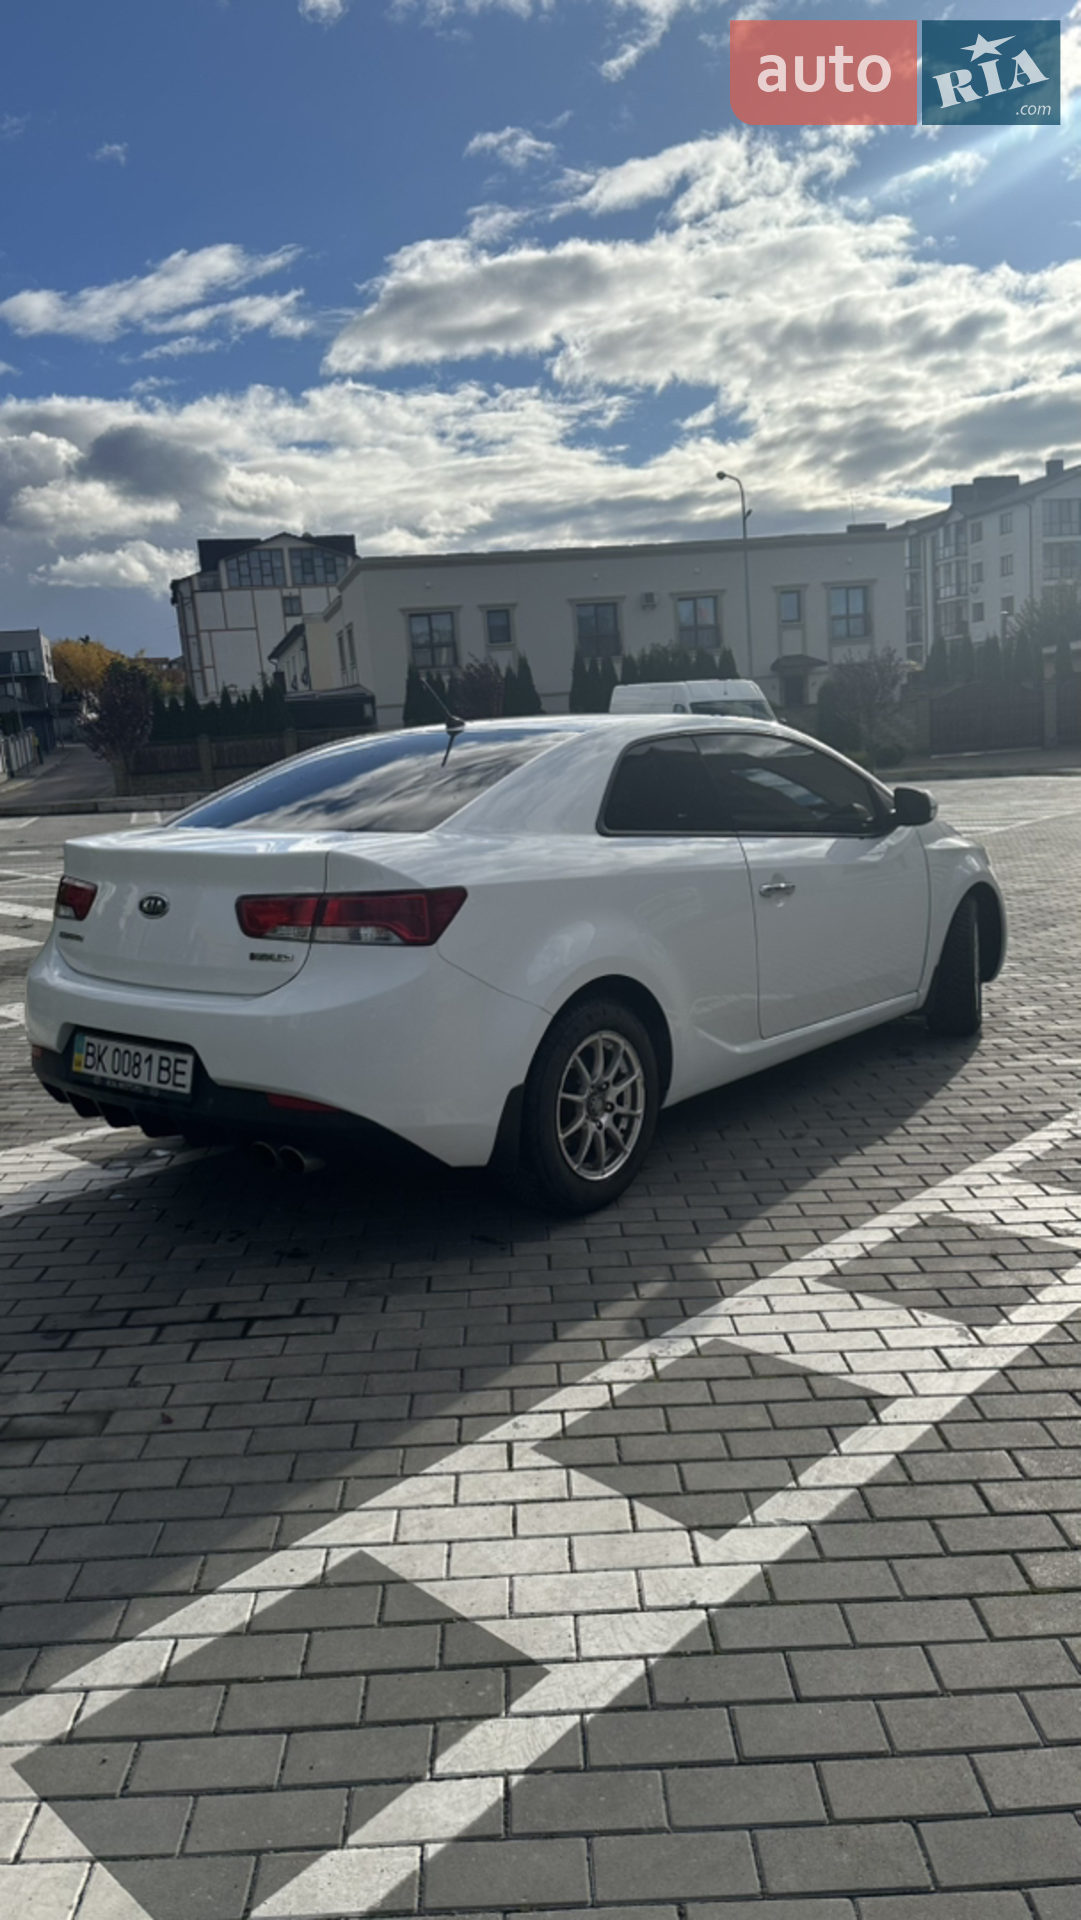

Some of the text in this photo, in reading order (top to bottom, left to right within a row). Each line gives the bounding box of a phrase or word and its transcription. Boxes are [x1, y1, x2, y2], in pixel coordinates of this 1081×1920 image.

[84, 1041, 108, 1073] BK
[112, 1047, 153, 1082] 0081
[157, 1055, 188, 1089] BE
